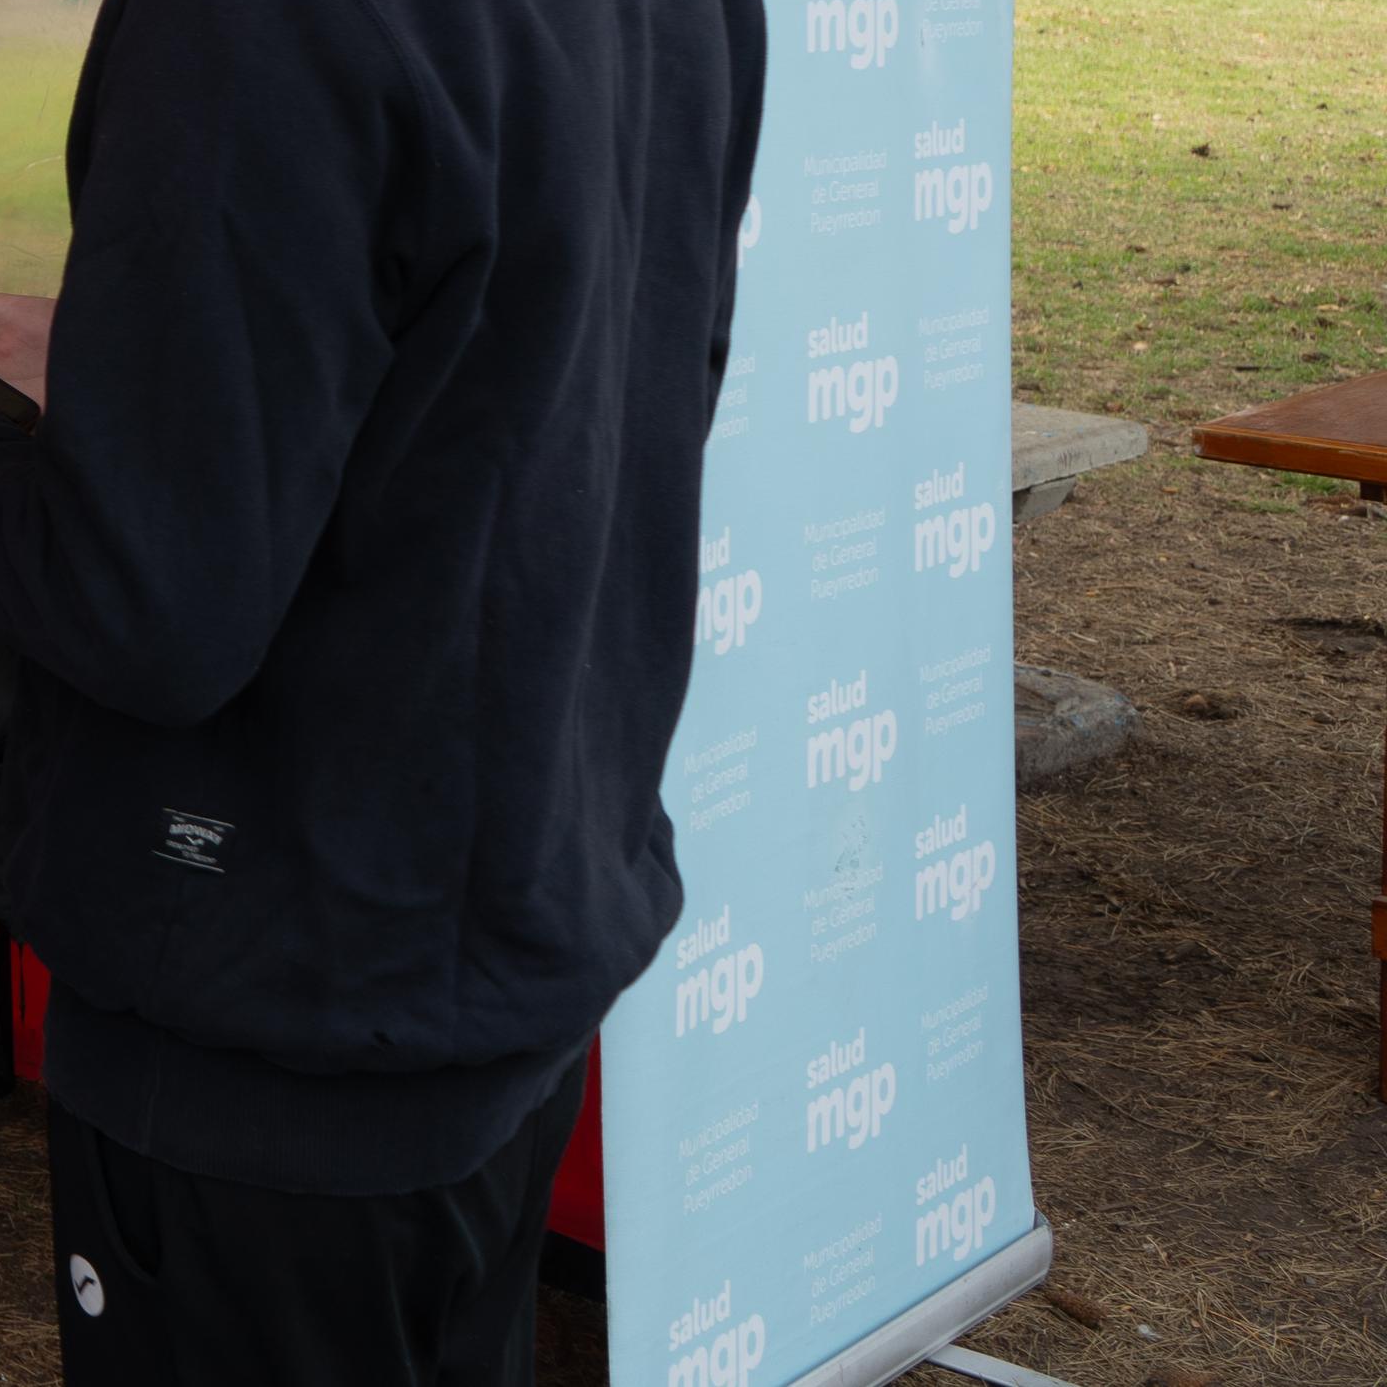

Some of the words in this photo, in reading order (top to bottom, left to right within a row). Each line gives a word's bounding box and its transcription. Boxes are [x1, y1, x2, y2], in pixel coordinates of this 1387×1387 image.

[914, 117, 965, 160] salud
[914, 160, 992, 235] mgp
[807, 312, 869, 359] salud
[807, 354, 899, 434] mgp
[914, 460, 965, 511] salud
[914, 500, 995, 579] mgp
[806, 669, 867, 724] salud
[807, 709, 898, 792] mgp
[915, 803, 967, 861] salud
[915, 839, 996, 923] mgp
[675, 903, 729, 971] salud
[675, 940, 764, 1039] mgp
[806, 1026, 866, 1091] salud
[806, 1061, 896, 1154] mgp
[916, 1142, 968, 1207] salud
[803, 1211, 884, 1274] Municipalidad
[916, 1174, 996, 1268] mgp
[810, 1274, 878, 1327] Pueyrredon
[811, 1275, 828, 1299] de
[827, 1247, 876, 1292] General
[667, 1311, 765, 1387] mgp
[668, 1278, 731, 1352] salud
